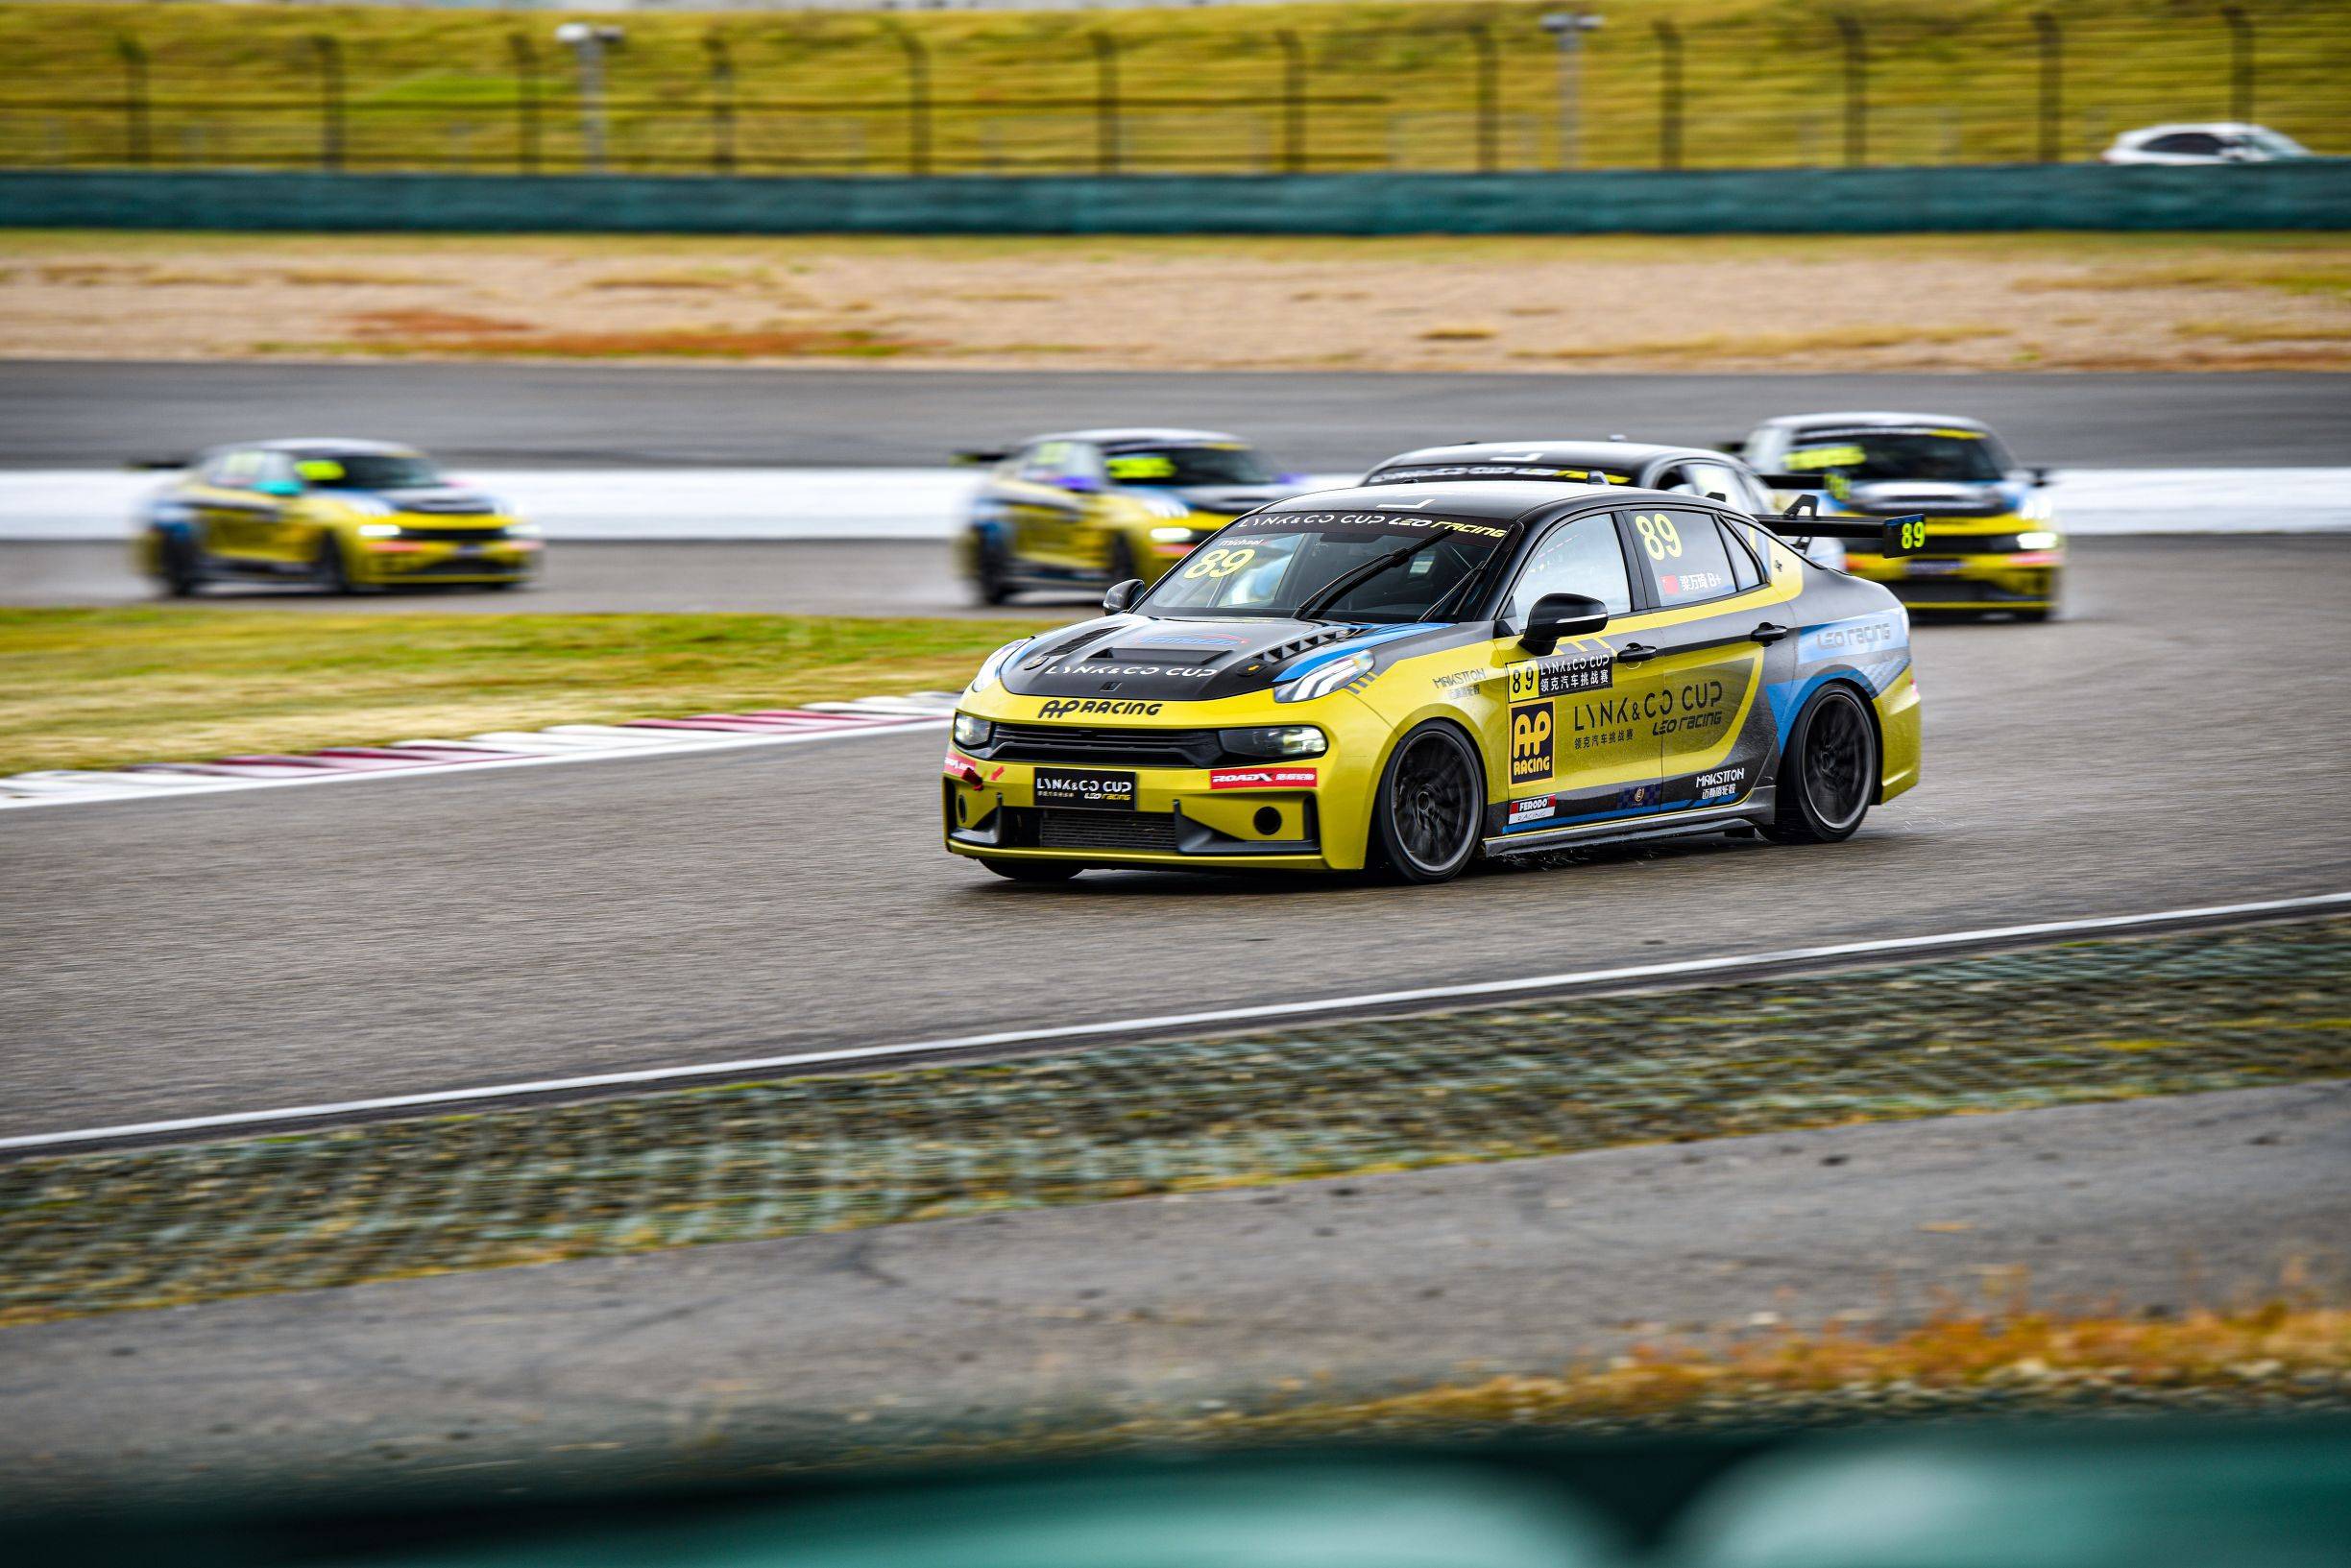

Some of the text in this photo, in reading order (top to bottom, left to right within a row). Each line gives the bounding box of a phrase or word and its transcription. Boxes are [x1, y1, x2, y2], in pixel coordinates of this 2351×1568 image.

[1340, 514, 1386, 525] CUP
[1388, 516, 1433, 527] LEO
[1635, 513, 1683, 561] 89
[1901, 521, 1926, 549] 89
[1183, 548, 1256, 579] 89
[1589, 653, 1610, 668] CUP
[1165, 666, 1219, 678] CUP
[1512, 665, 1535, 694] 89
[1539, 669, 1609, 692] 领克汽车挑战赛
[1682, 681, 1723, 712] CUP
[1037, 699, 1164, 720] AP RACING
[1514, 710, 1552, 759] AP
[1652, 718, 1678, 736] LEO
[1574, 728, 1634, 750] 领克汽车挑战赛
[1514, 755, 1551, 776] RACING
[1103, 781, 1132, 793] CUP
[1212, 772, 1273, 783] ROADX
[1518, 797, 1548, 811] FERODO
